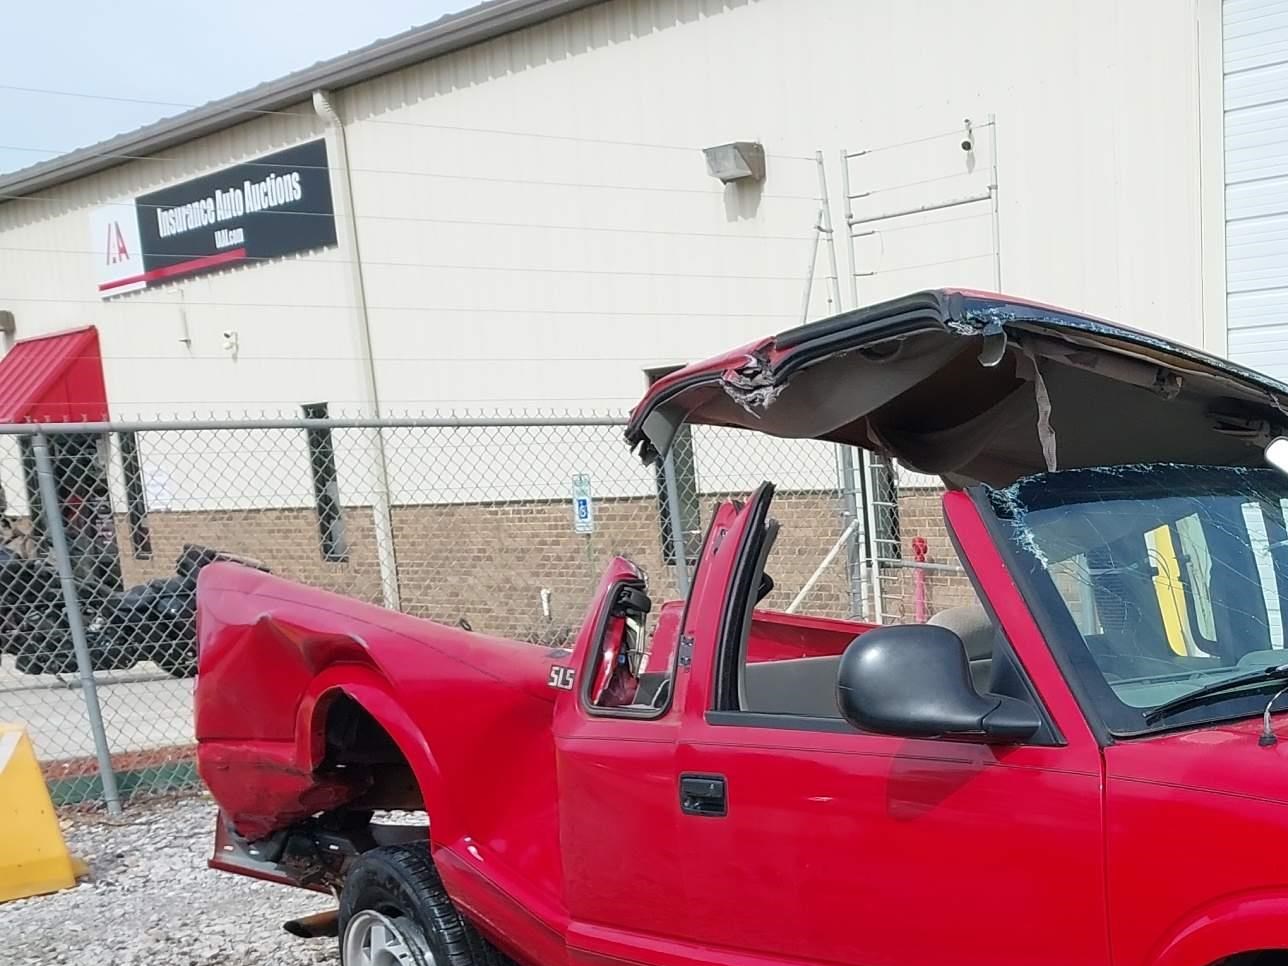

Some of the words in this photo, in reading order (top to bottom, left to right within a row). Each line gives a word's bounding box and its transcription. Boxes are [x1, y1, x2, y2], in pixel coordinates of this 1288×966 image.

[157, 197, 216, 238] Insurance
[215, 187, 244, 221] Auto
[243, 171, 302, 214] Auctions
[548, 665, 576, 690] SLS
